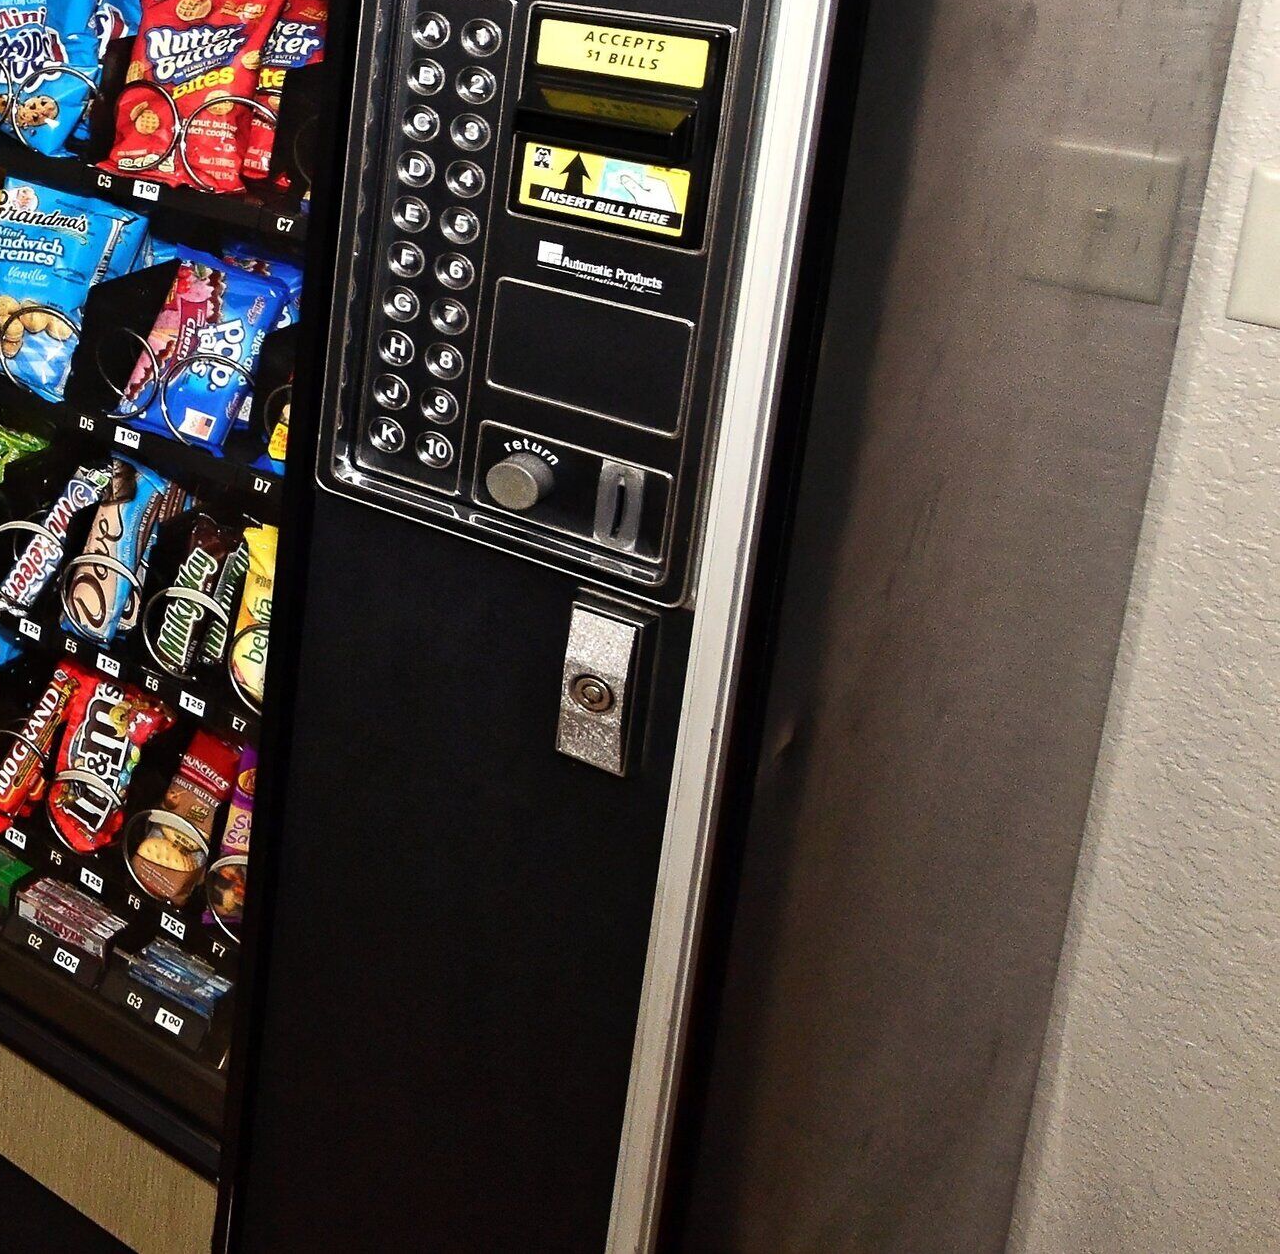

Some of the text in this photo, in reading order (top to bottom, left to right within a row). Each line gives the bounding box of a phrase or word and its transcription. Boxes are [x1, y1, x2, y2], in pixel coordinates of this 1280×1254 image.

[149, 25, 243, 60] Nutter
[422, 19, 439, 37] A
[584, 30, 667, 53] ACCEPTS
[155, 35, 246, 80] Butter
[608, 52, 660, 71] BILLS
[419, 66, 486, 94] B 2
[413, 113, 479, 140] C 3
[408, 159, 475, 187] D 4
[97, 174, 294, 232] C5 C7
[405, 203, 468, 233] E 5
[540, 186, 670, 226] INSERT BILL HERE
[8, 266, 48, 280] Vanilla
[400, 248, 463, 278] F 6
[562, 256, 663, 290] Automatic Products
[393, 293, 458, 324] G 7
[389, 337, 453, 370] H 8
[386, 380, 448, 415] J 9
[79, 416, 95, 432] D5
[254, 477, 272, 494] D7
[381, 424, 448, 459] K 10
[503, 436, 561, 468] return
[65, 638, 77, 653] E5
[145, 675, 159, 691] E6
[231, 716, 247, 731] E7
[50, 850, 63, 866] F5
[127, 894, 141, 910] F6
[213, 941, 226, 958] F7
[27, 934, 42, 950] G2
[126, 993, 143, 1009] G3
